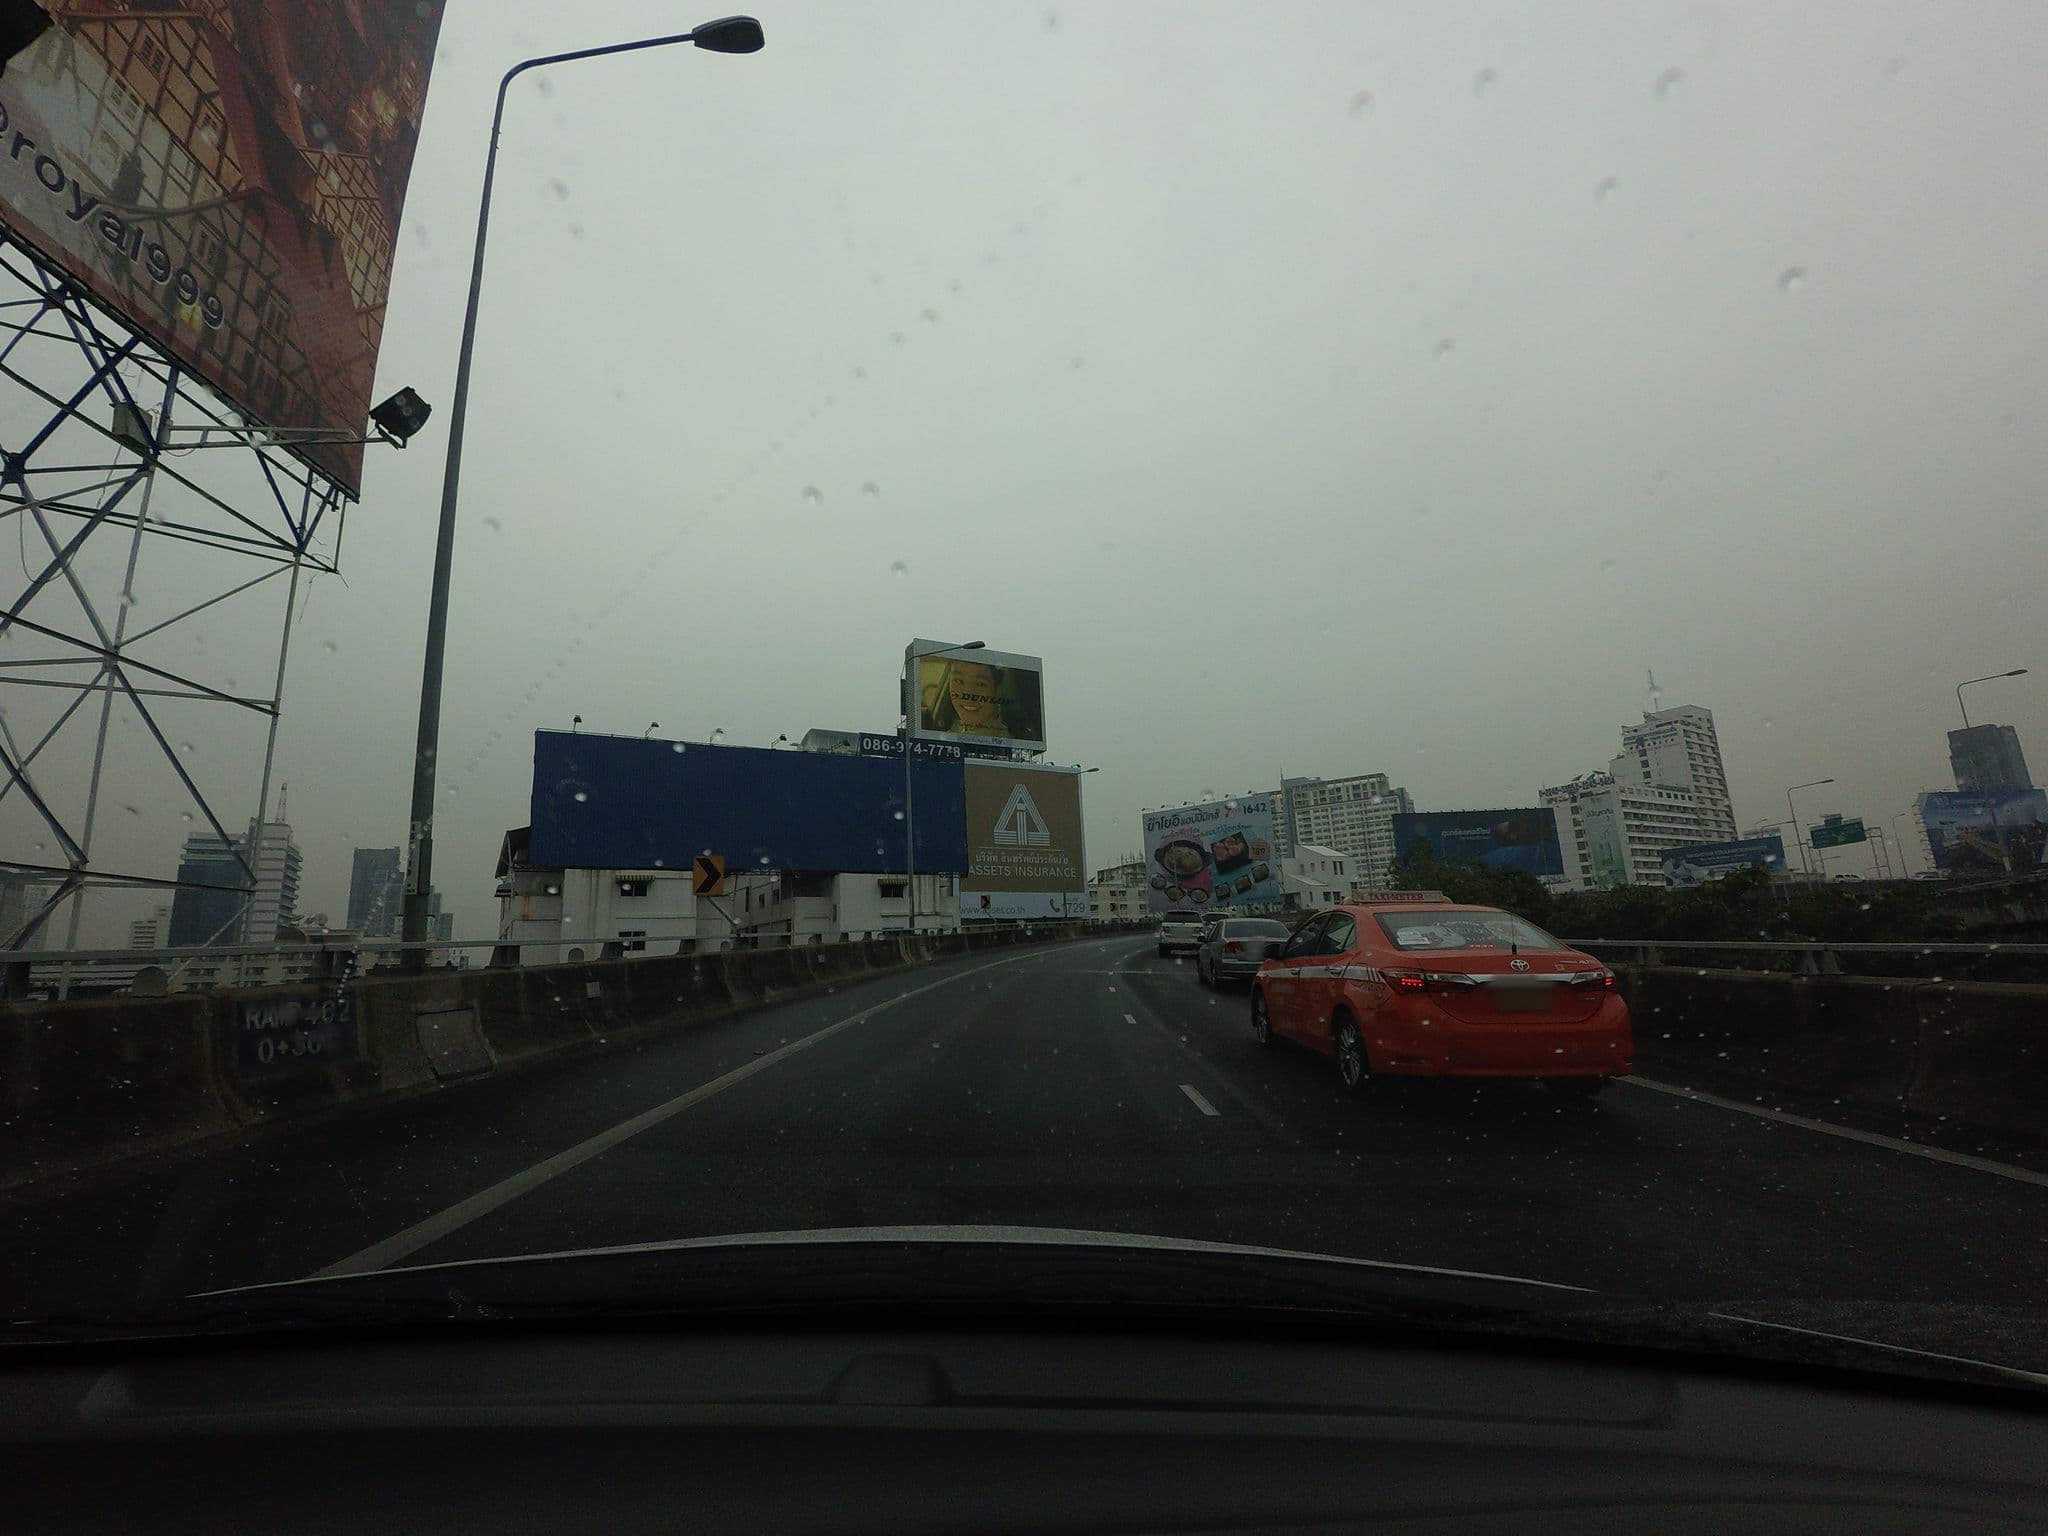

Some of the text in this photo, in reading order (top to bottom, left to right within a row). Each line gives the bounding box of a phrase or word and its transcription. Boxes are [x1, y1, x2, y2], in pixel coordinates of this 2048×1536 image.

[0, 100, 225, 330] royal999
[1243, 803, 1267, 815] 1642
[968, 865, 1076, 878] ASSETS INSURANCE
